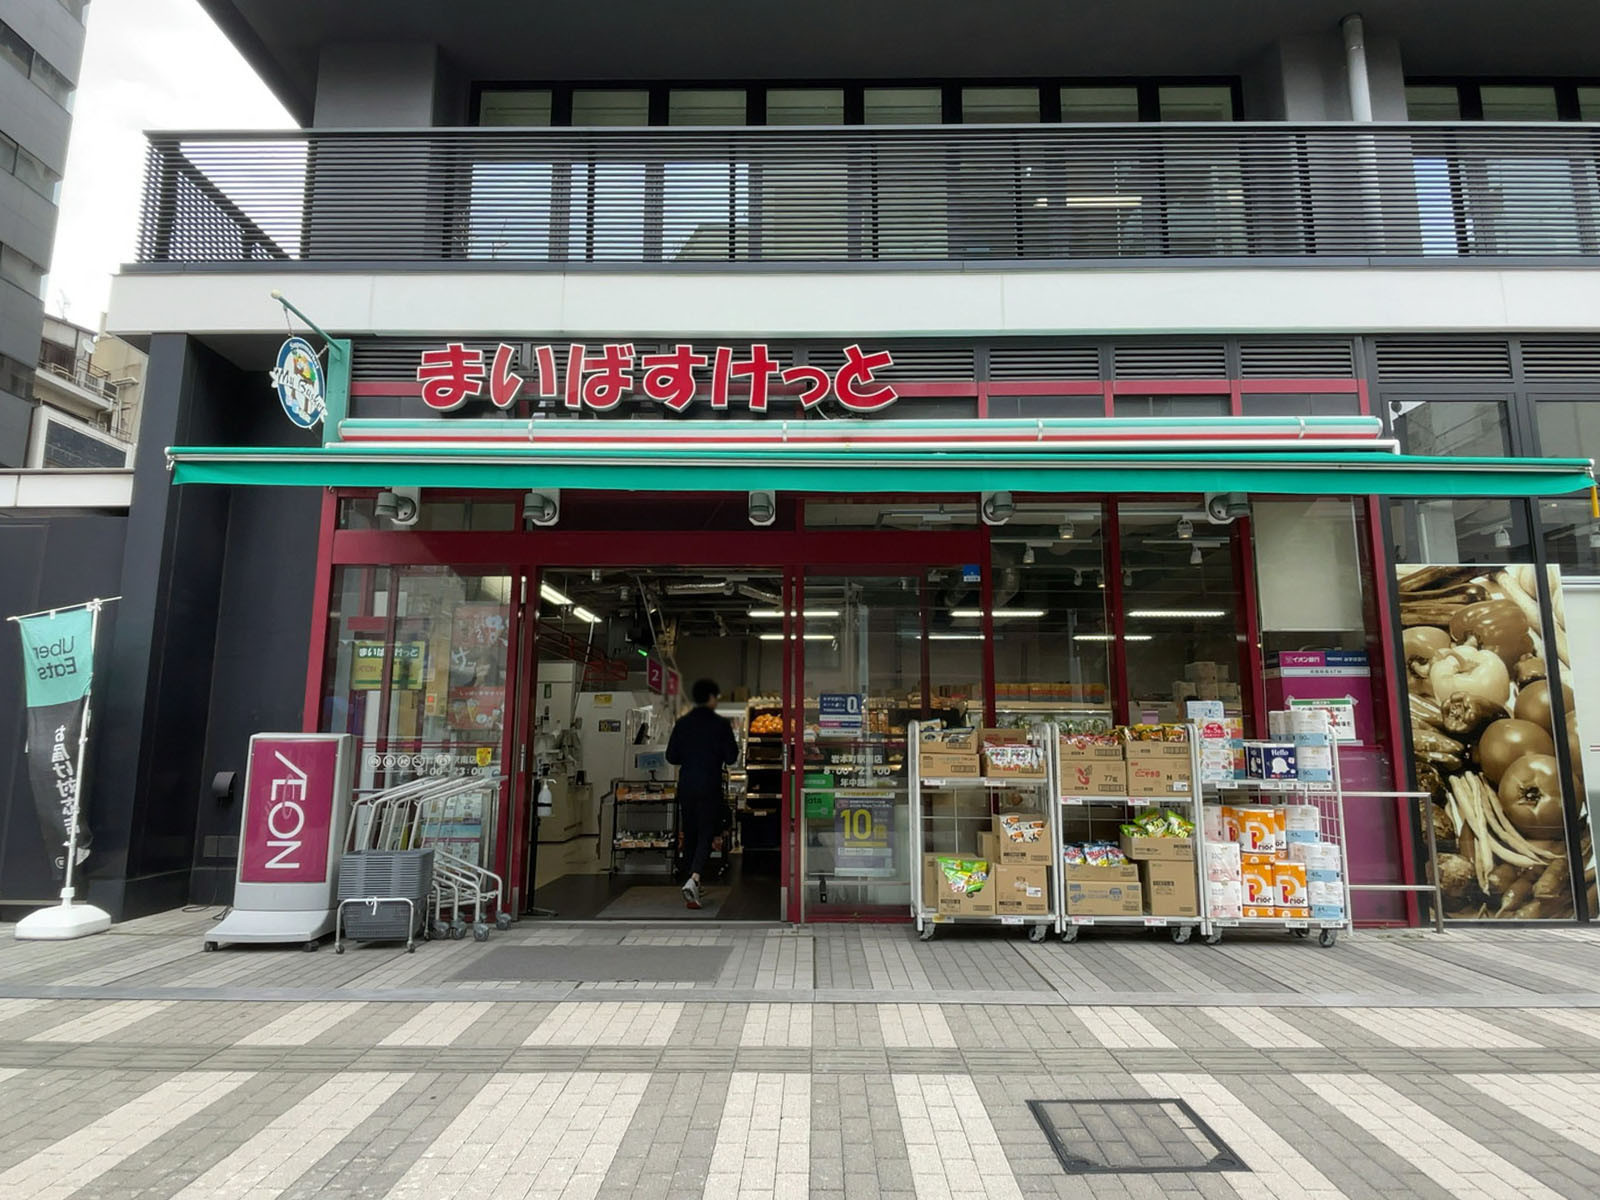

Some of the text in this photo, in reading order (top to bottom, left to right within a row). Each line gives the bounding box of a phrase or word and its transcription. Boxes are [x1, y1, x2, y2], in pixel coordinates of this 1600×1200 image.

[416, 342, 900, 413] まいばすけっと
[359, 646, 418, 657] まいばけっと
[652, 669, 660, 682] 2
[1271, 749, 1289, 757] Hello
[264, 750, 308, 869] AEON
